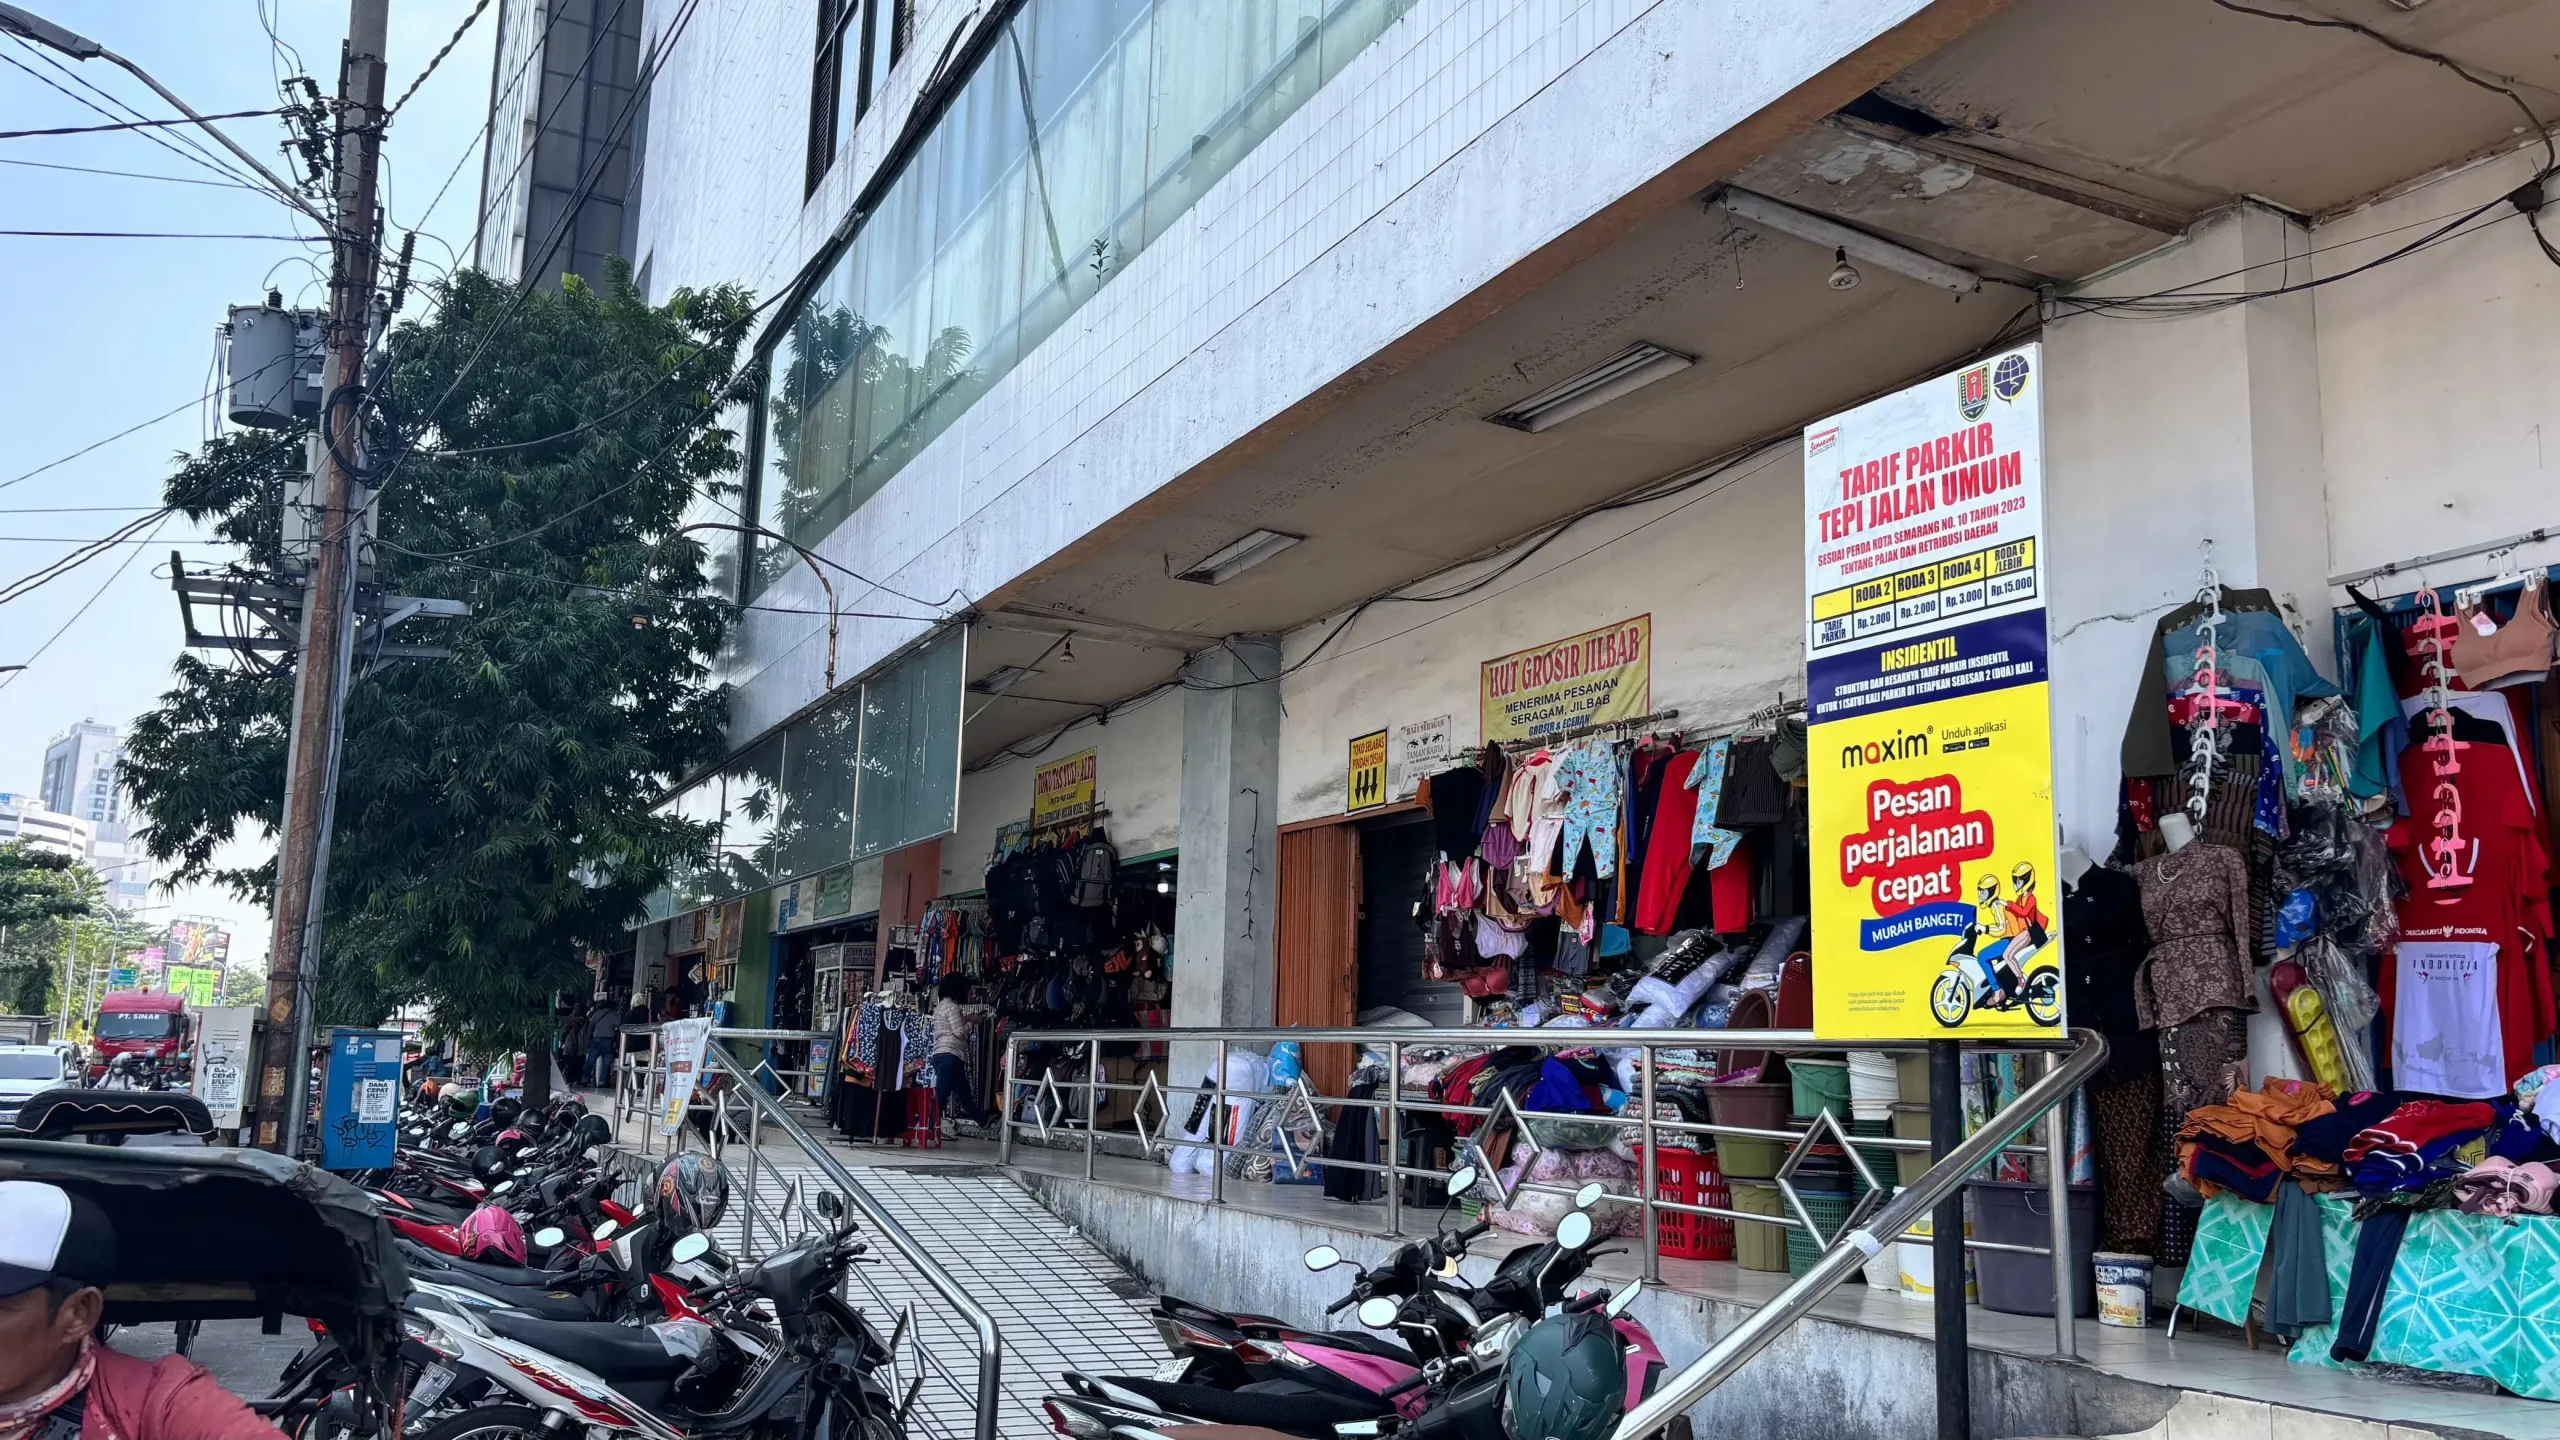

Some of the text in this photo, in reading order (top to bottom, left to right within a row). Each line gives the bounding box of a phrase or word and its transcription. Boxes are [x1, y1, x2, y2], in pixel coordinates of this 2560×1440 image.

[1840, 422, 1994, 501] TARIF PARKIR
[1819, 451, 2022, 543] TEPI JALAN UMUM
[1818, 496, 2025, 566] SESUAI PERDA KOTA SEMARANG NO. 10 TAHUN 2023
[1840, 521, 1998, 575] TENTANG PAJAK DAN RETRIBUSI DAERAH
[1995, 543, 2025, 561] RODA 6
[1944, 557, 1981, 581] RODA 4
[1995, 556, 2022, 573] /LEBIH
[1856, 581, 1890, 603] RODA 2
[1898, 570, 1935, 592] RODA 3
[1991, 576, 2032, 596] Rp.15.000
[1901, 600, 1935, 619] Rp. 2.000
[1946, 589, 1982, 607] Rp. 3.000
[1824, 619, 1843, 632] TARIF
[1858, 612, 1890, 629] Rp. 2.000
[1822, 629, 1846, 643] PARKIR
[1489, 626, 1639, 698] UUT GROSIR JILBAB
[1881, 636, 1958, 672] INSIDENTIL
[1816, 701, 1838, 714] UNTUK
[1838, 700, 1842, 709] 1
[1866, 692, 1880, 704] KALI
[1881, 687, 1906, 701] PARKIR
[1907, 685, 1915, 696] DI
[1916, 678, 1951, 694] TETAPKAN
[1952, 671, 1984, 687] SEBESAR
[1985, 670, 1991, 680] 2
[1992, 665, 2014, 680] (DUA)
[2015, 661, 2033, 675] KALI
[1835, 651, 2009, 696] STRUKTUR DAN BESARNYA TARIF PARKIR INSIDENTIL
[1505, 677, 1619, 714] MENERIMA PESANAN
[1511, 694, 1610, 726] SERAGAM, JILBAB
[1528, 713, 1591, 737] GROSIR & ECERAN
[1942, 720, 2006, 740] Unduh aplikasi
[1842, 729, 1927, 768] maxim
[1873, 784, 1951, 820] Pesan
[1846, 821, 1983, 873] perjalanan
[1878, 864, 1951, 905] cepat
[1872, 914, 1963, 943] MURAH BANGET!
[2413, 959, 2477, 970] INDONESIA
